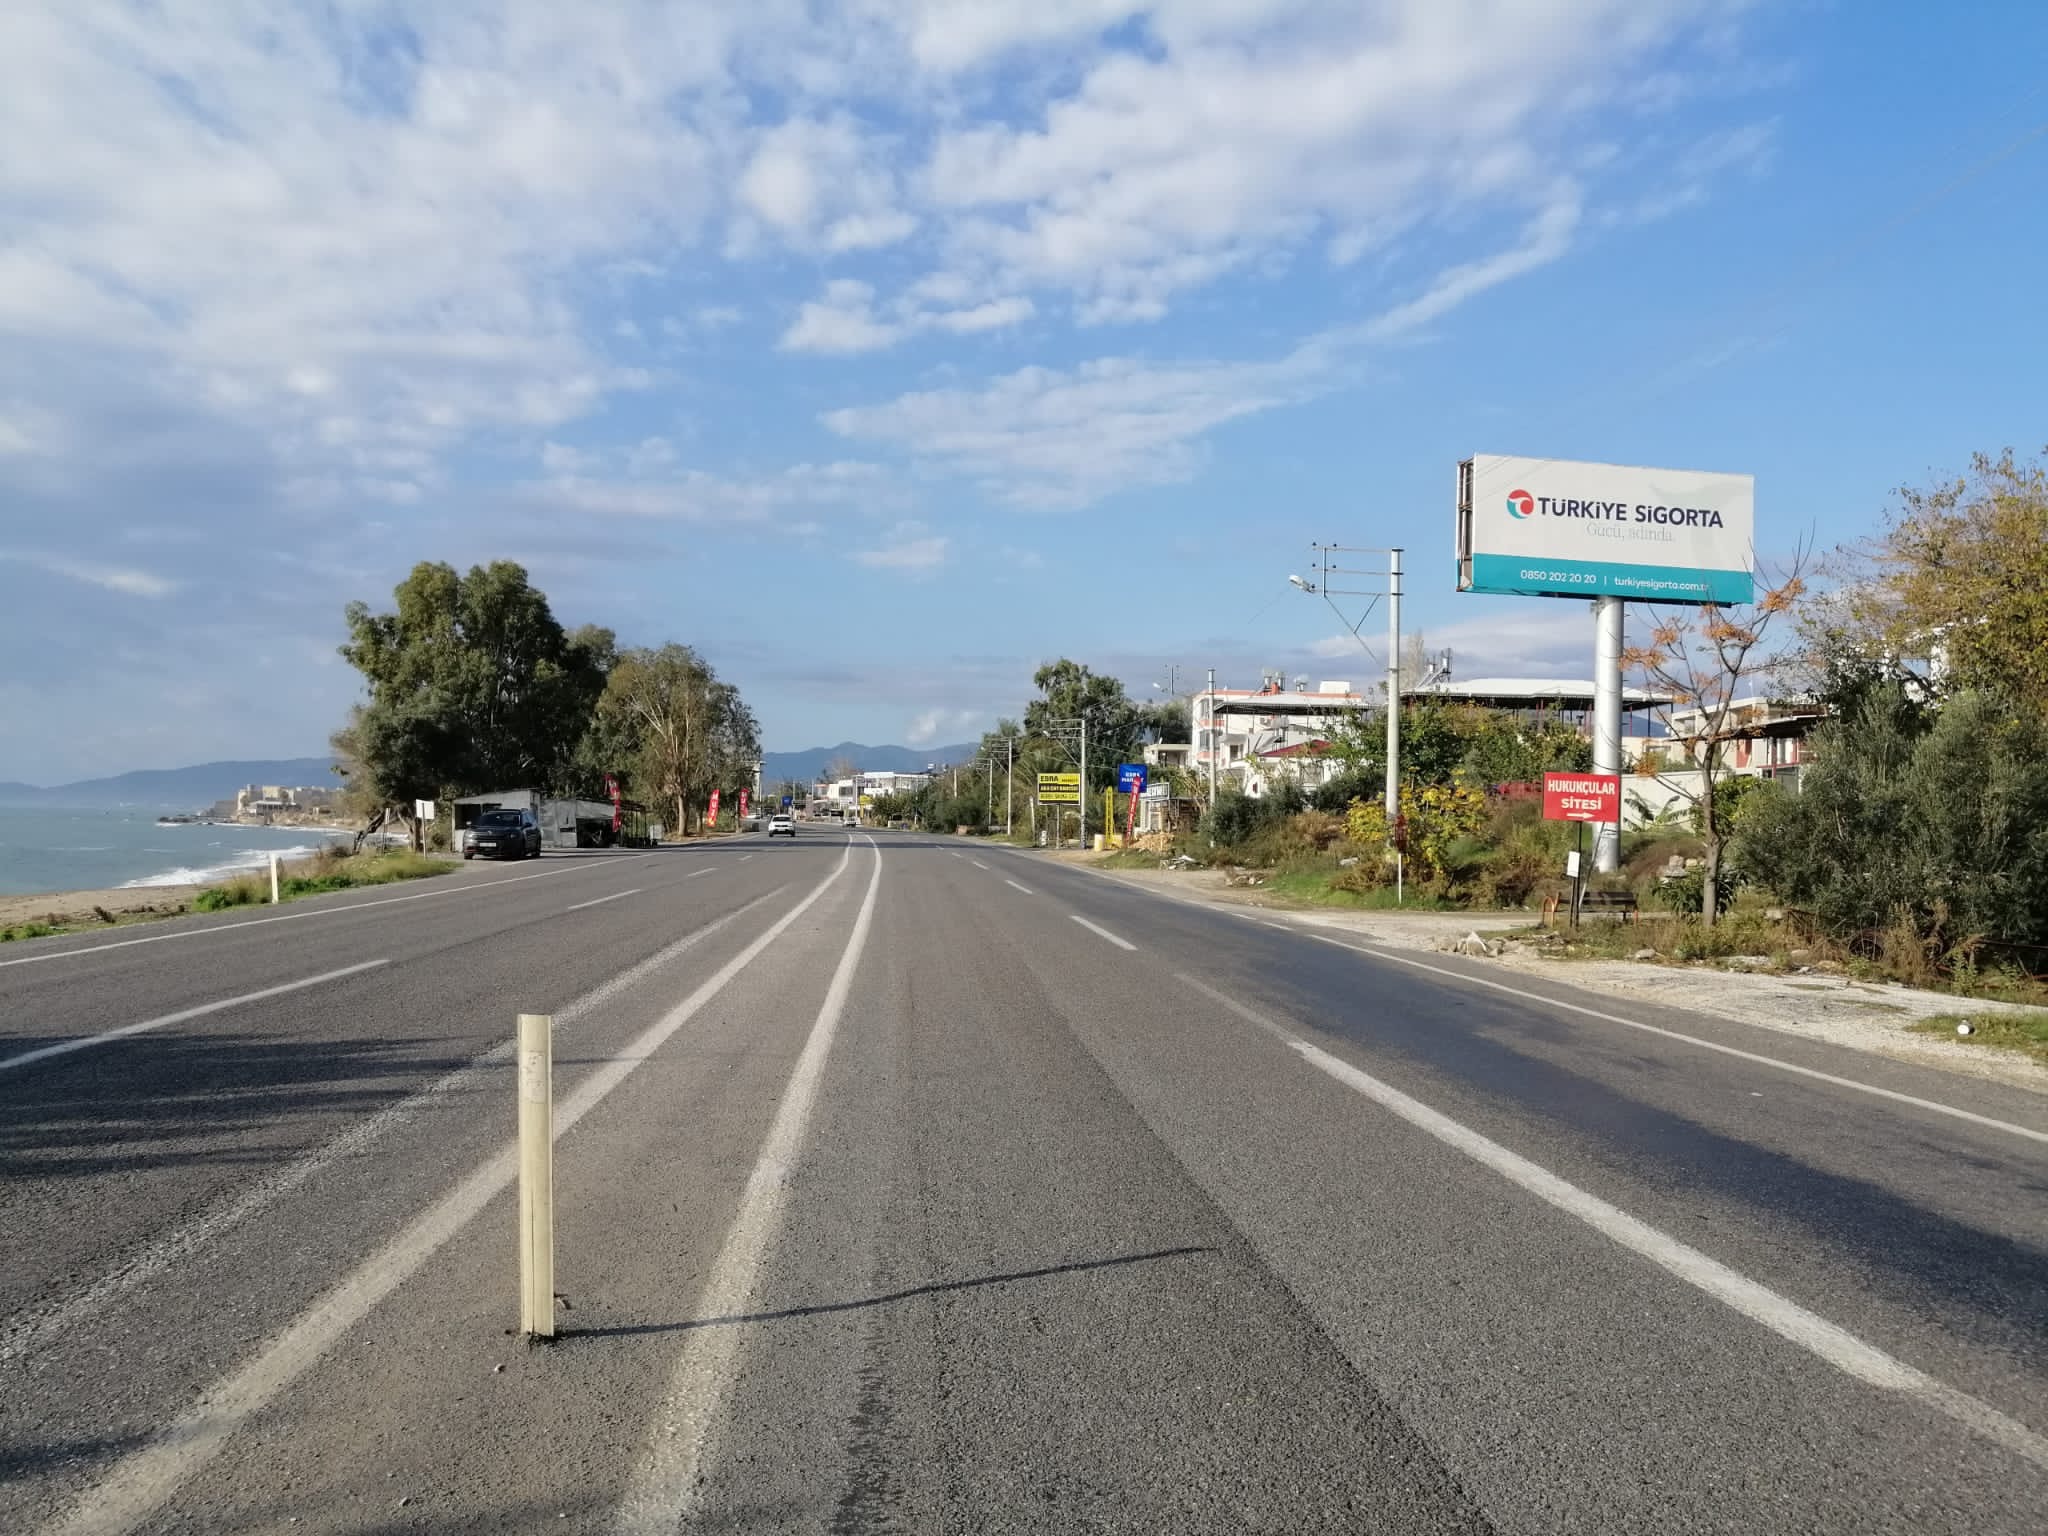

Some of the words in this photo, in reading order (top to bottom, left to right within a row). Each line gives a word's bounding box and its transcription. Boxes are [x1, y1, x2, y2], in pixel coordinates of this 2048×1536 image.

[1520, 569, 1547, 580] 0850
[1549, 571, 1566, 582] 202
[1568, 573, 1582, 583] 20
[1584, 573, 1596, 584] 20
[1548, 779, 1615, 795] HUKUKÇULAR
[1561, 796, 1602, 810] SİTESİ
